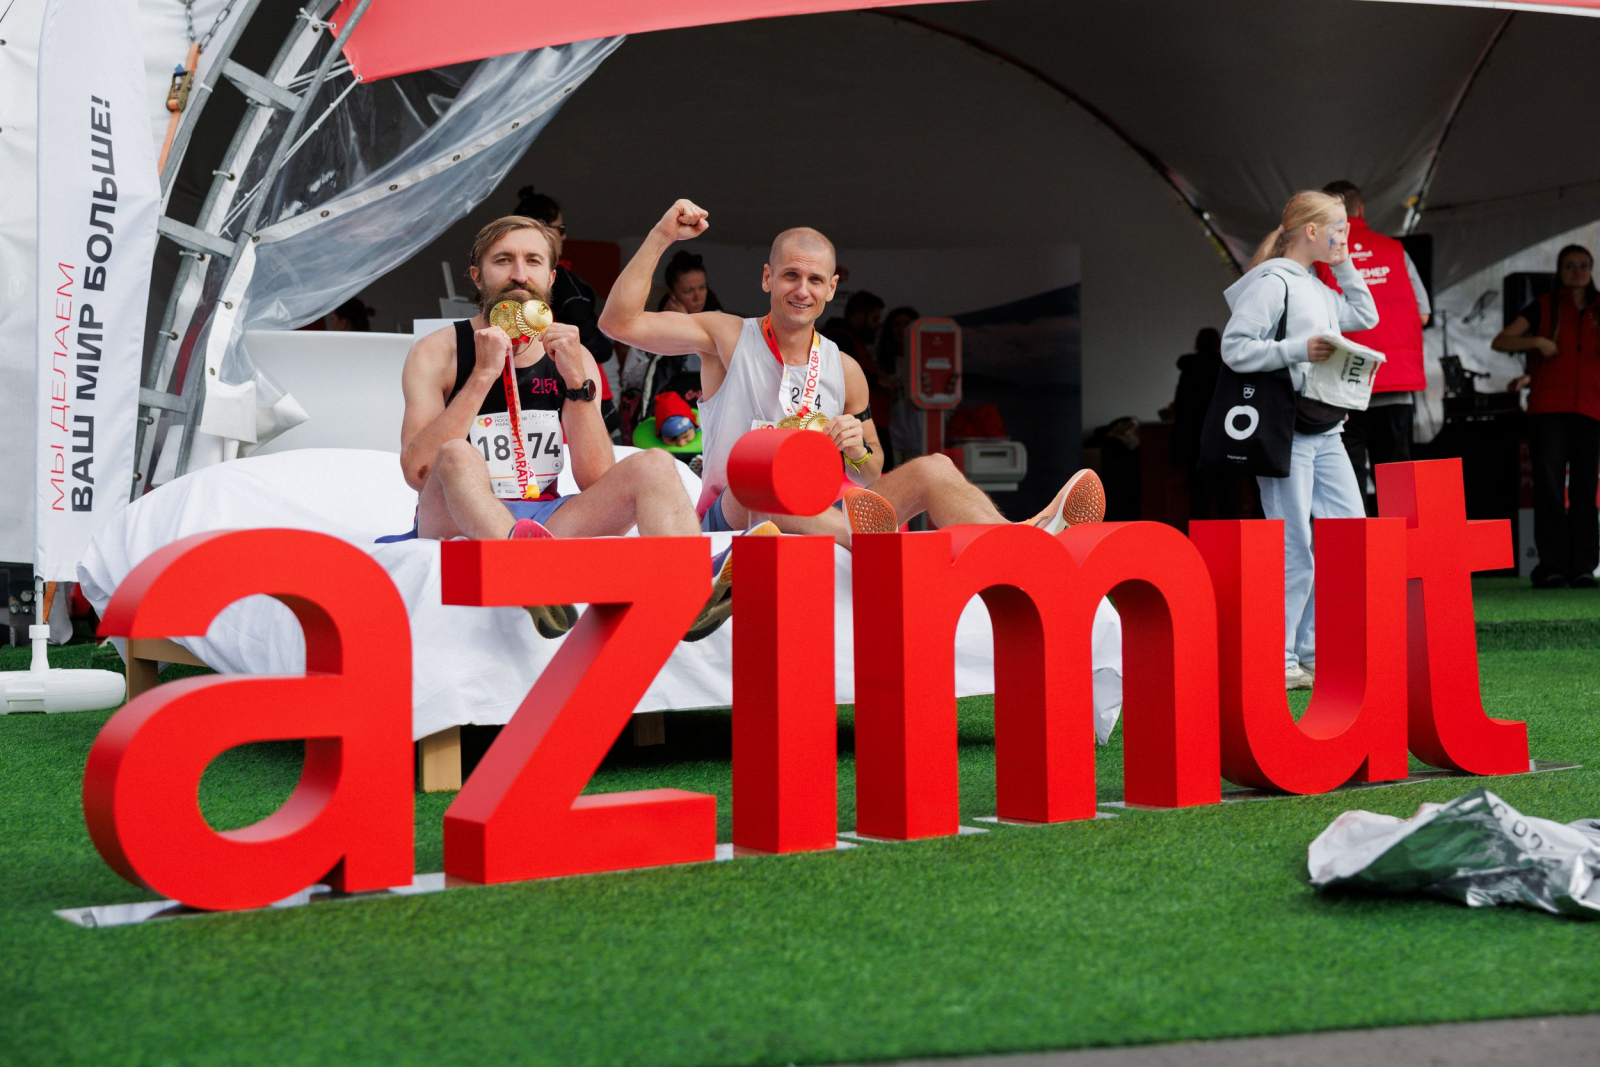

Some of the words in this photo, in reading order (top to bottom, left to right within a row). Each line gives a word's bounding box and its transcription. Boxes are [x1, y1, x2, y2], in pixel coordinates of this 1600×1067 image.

[83, 94, 118, 292] БОЛЬШЕ!
[50, 262, 75, 432] ДЕЛАЕМ
[76, 303, 104, 401] МИР
[803, 350, 820, 400] МОСКВА
[50, 444, 65, 511] МЫ
[71, 414, 95, 512] ВАШ
[477, 431, 561, 462] 1874
[82, 428, 1531, 910] azimut
